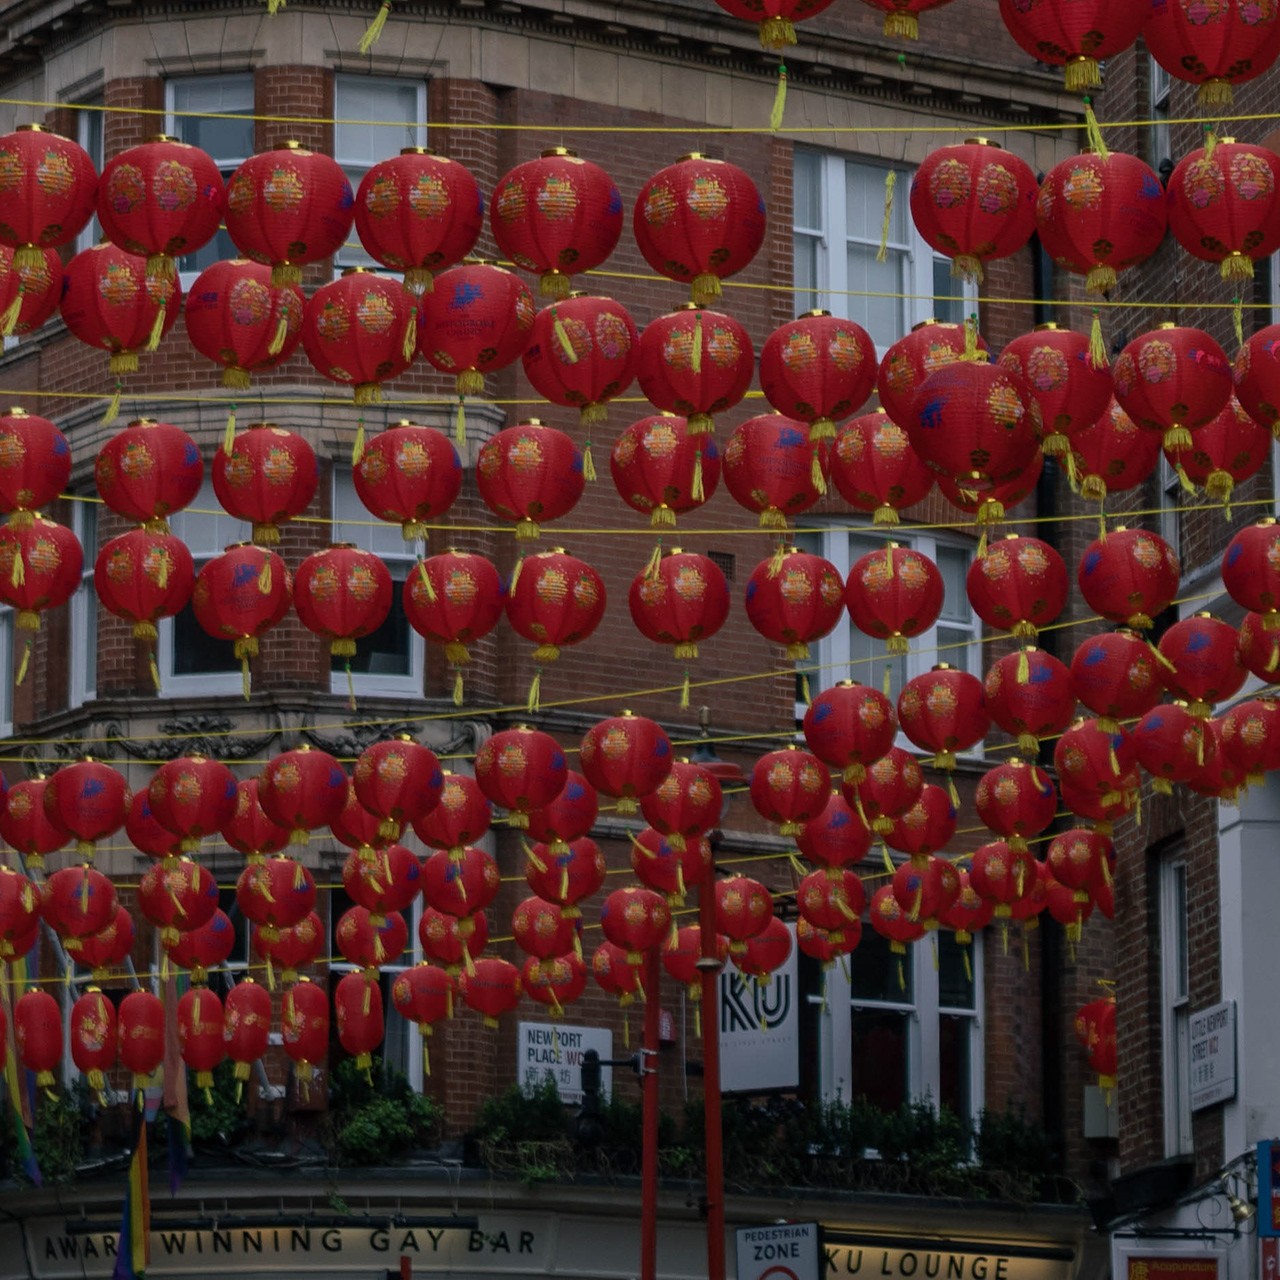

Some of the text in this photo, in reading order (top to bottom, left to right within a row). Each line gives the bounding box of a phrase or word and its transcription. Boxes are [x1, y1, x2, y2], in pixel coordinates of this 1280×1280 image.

[721, 971, 790, 1033] KU
[528, 1029, 583, 1048] NEWPORT
[527, 1047, 586, 1066] PLACE WC
[45, 1228, 535, 1261] AWAR WINNING GAY BAR
[744, 1227, 810, 1243] PEDESTRIAN
[753, 1242, 801, 1261] ZONE
[824, 1249, 1010, 1280] KU LOUNGE
